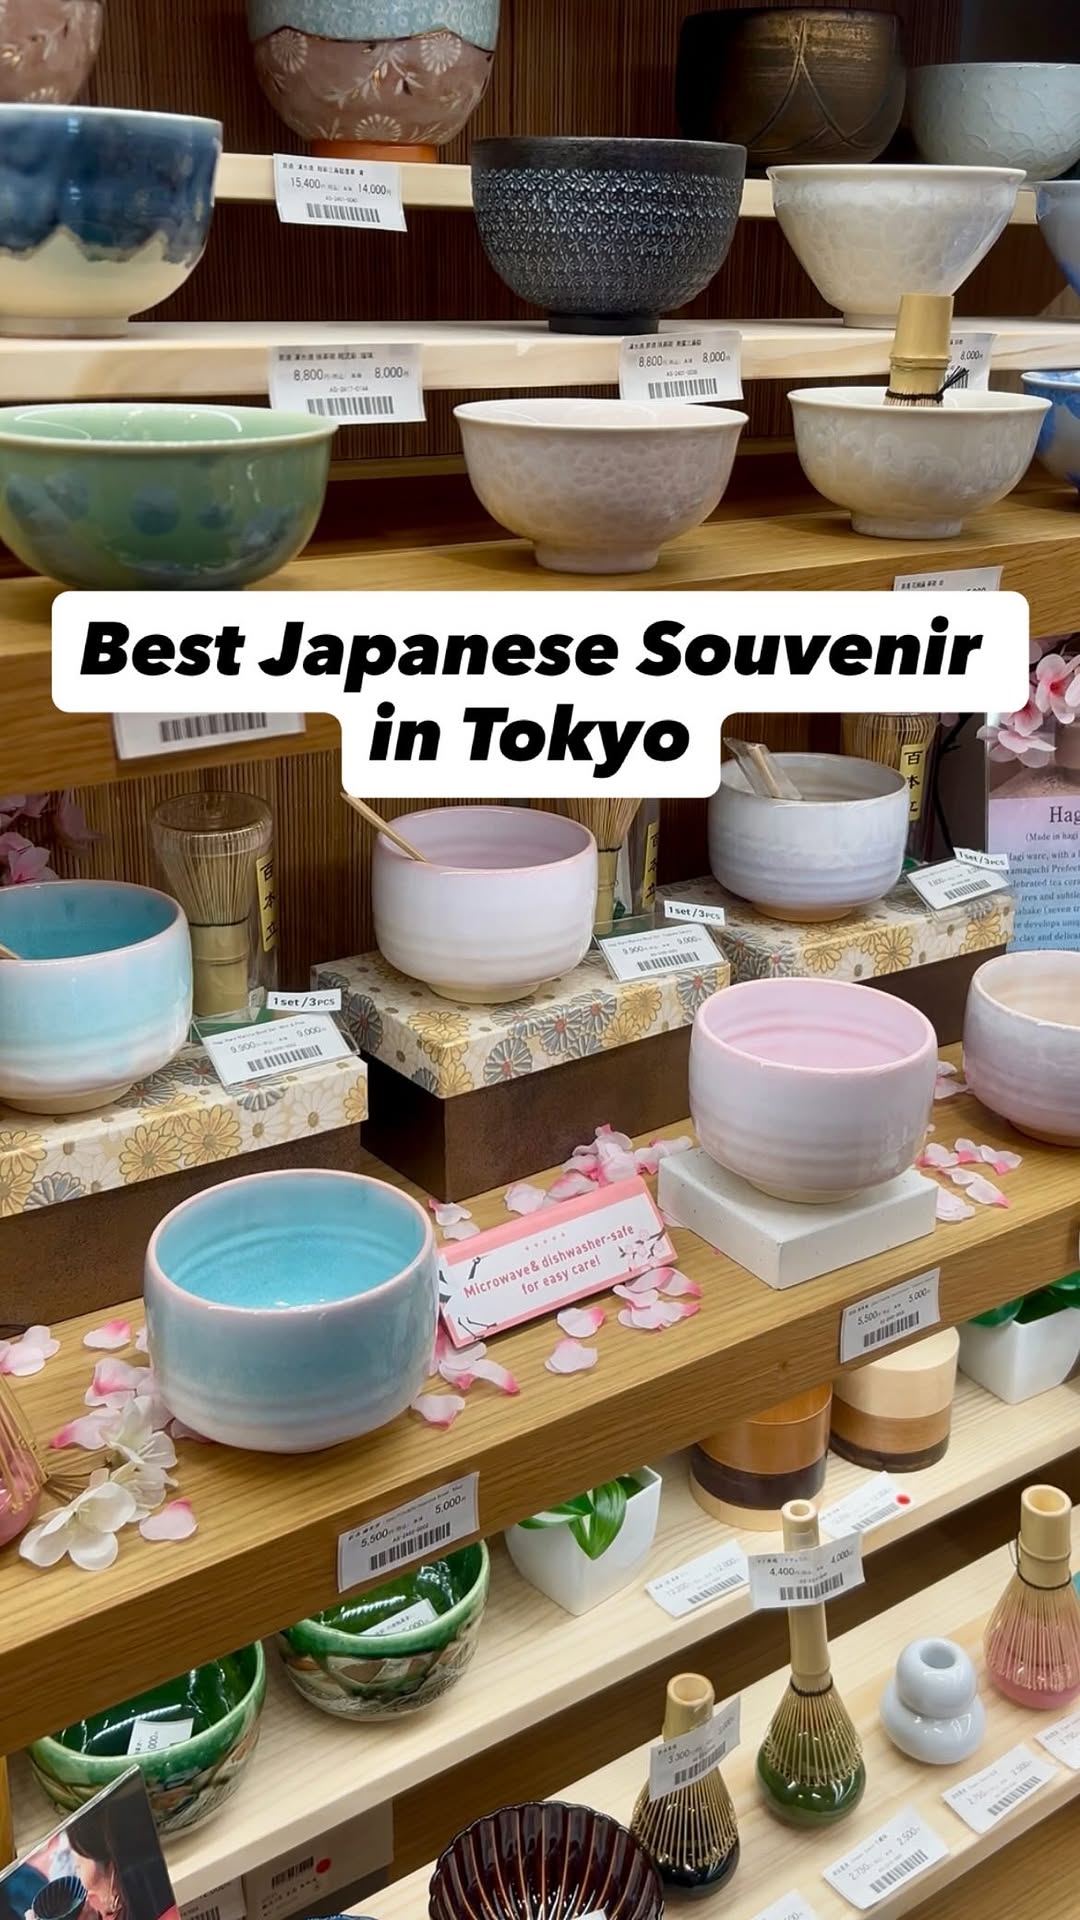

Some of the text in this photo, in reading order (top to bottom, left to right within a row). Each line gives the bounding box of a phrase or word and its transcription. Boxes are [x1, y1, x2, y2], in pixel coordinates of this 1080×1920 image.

[1025, 831, 1079, 842] (Made in hagi
[1026, 852, 1050, 862] ware,
[1050, 850, 1069, 860] with
[542, 1223, 634, 1269] dishwasher-safe
[521, 1256, 601, 1295] for easy care!
